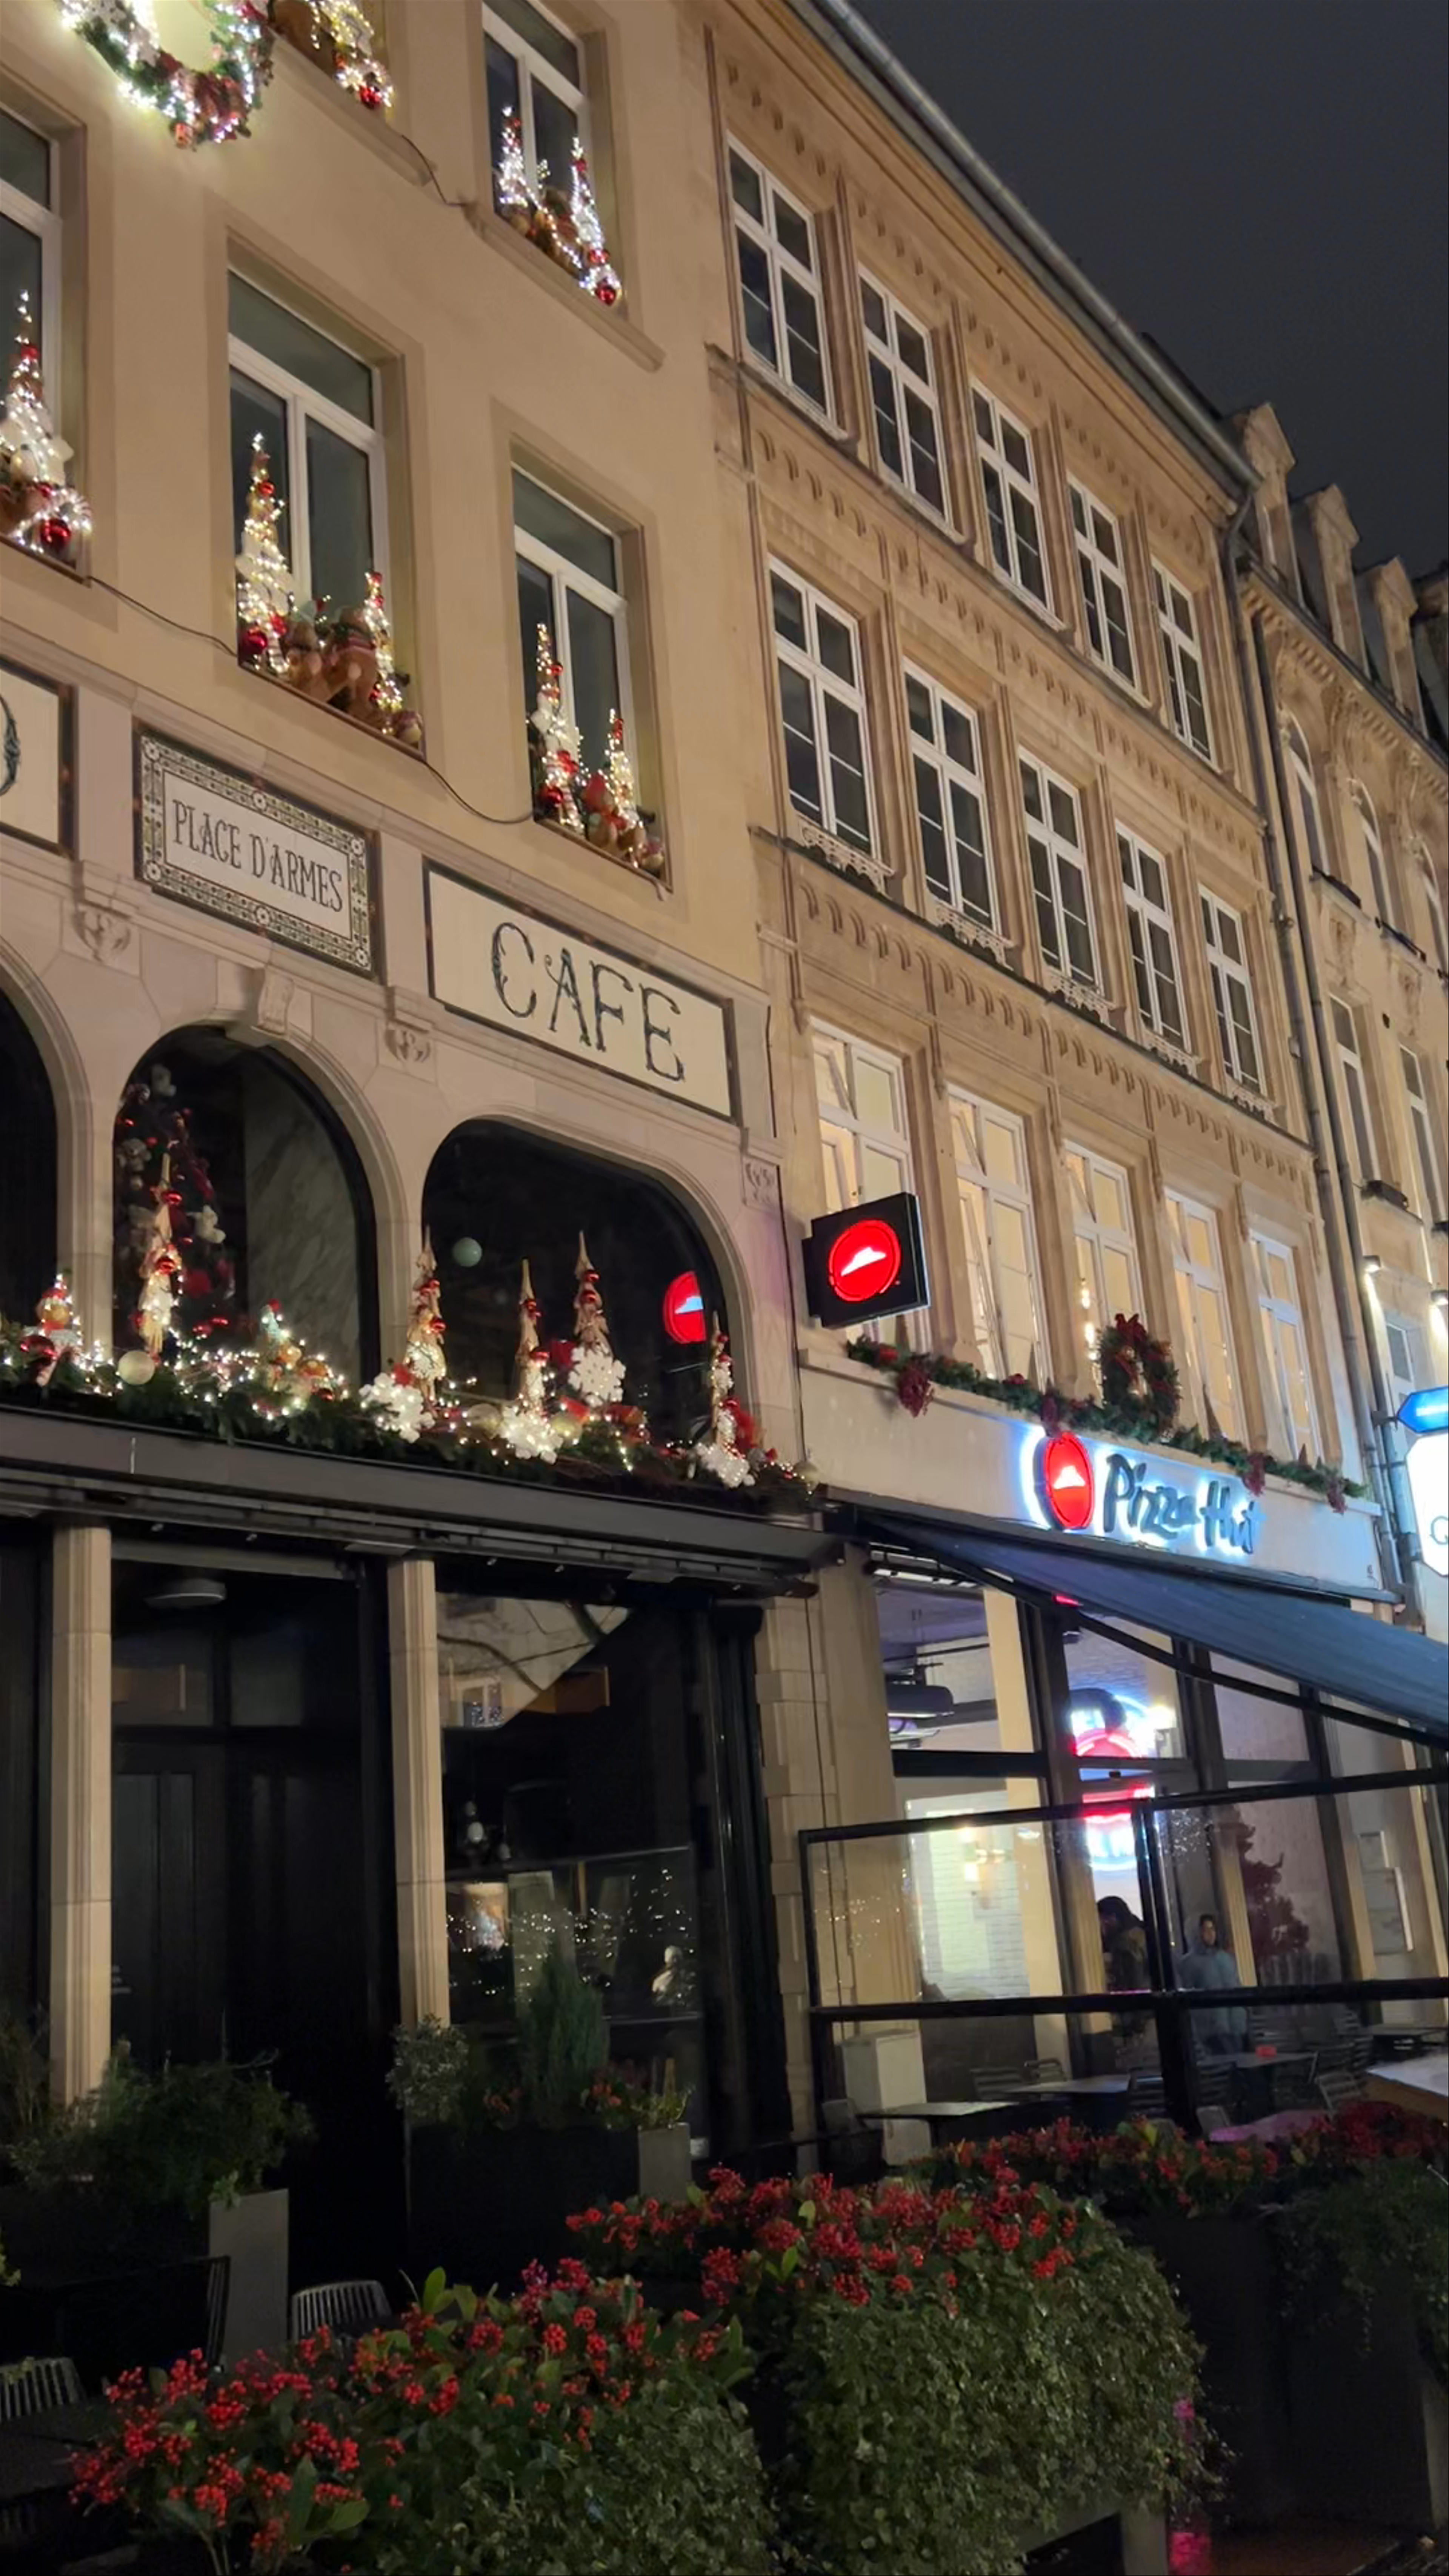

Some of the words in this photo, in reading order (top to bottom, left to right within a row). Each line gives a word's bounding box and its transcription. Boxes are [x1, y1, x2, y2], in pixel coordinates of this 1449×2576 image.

[172, 799, 242, 869] PLACE
[248, 834, 343, 912] D'ARMES
[492, 922, 685, 1082] CAFE
[1103, 1453, 1200, 1539] Pizza
[1200, 1480, 1267, 1554] Hut
